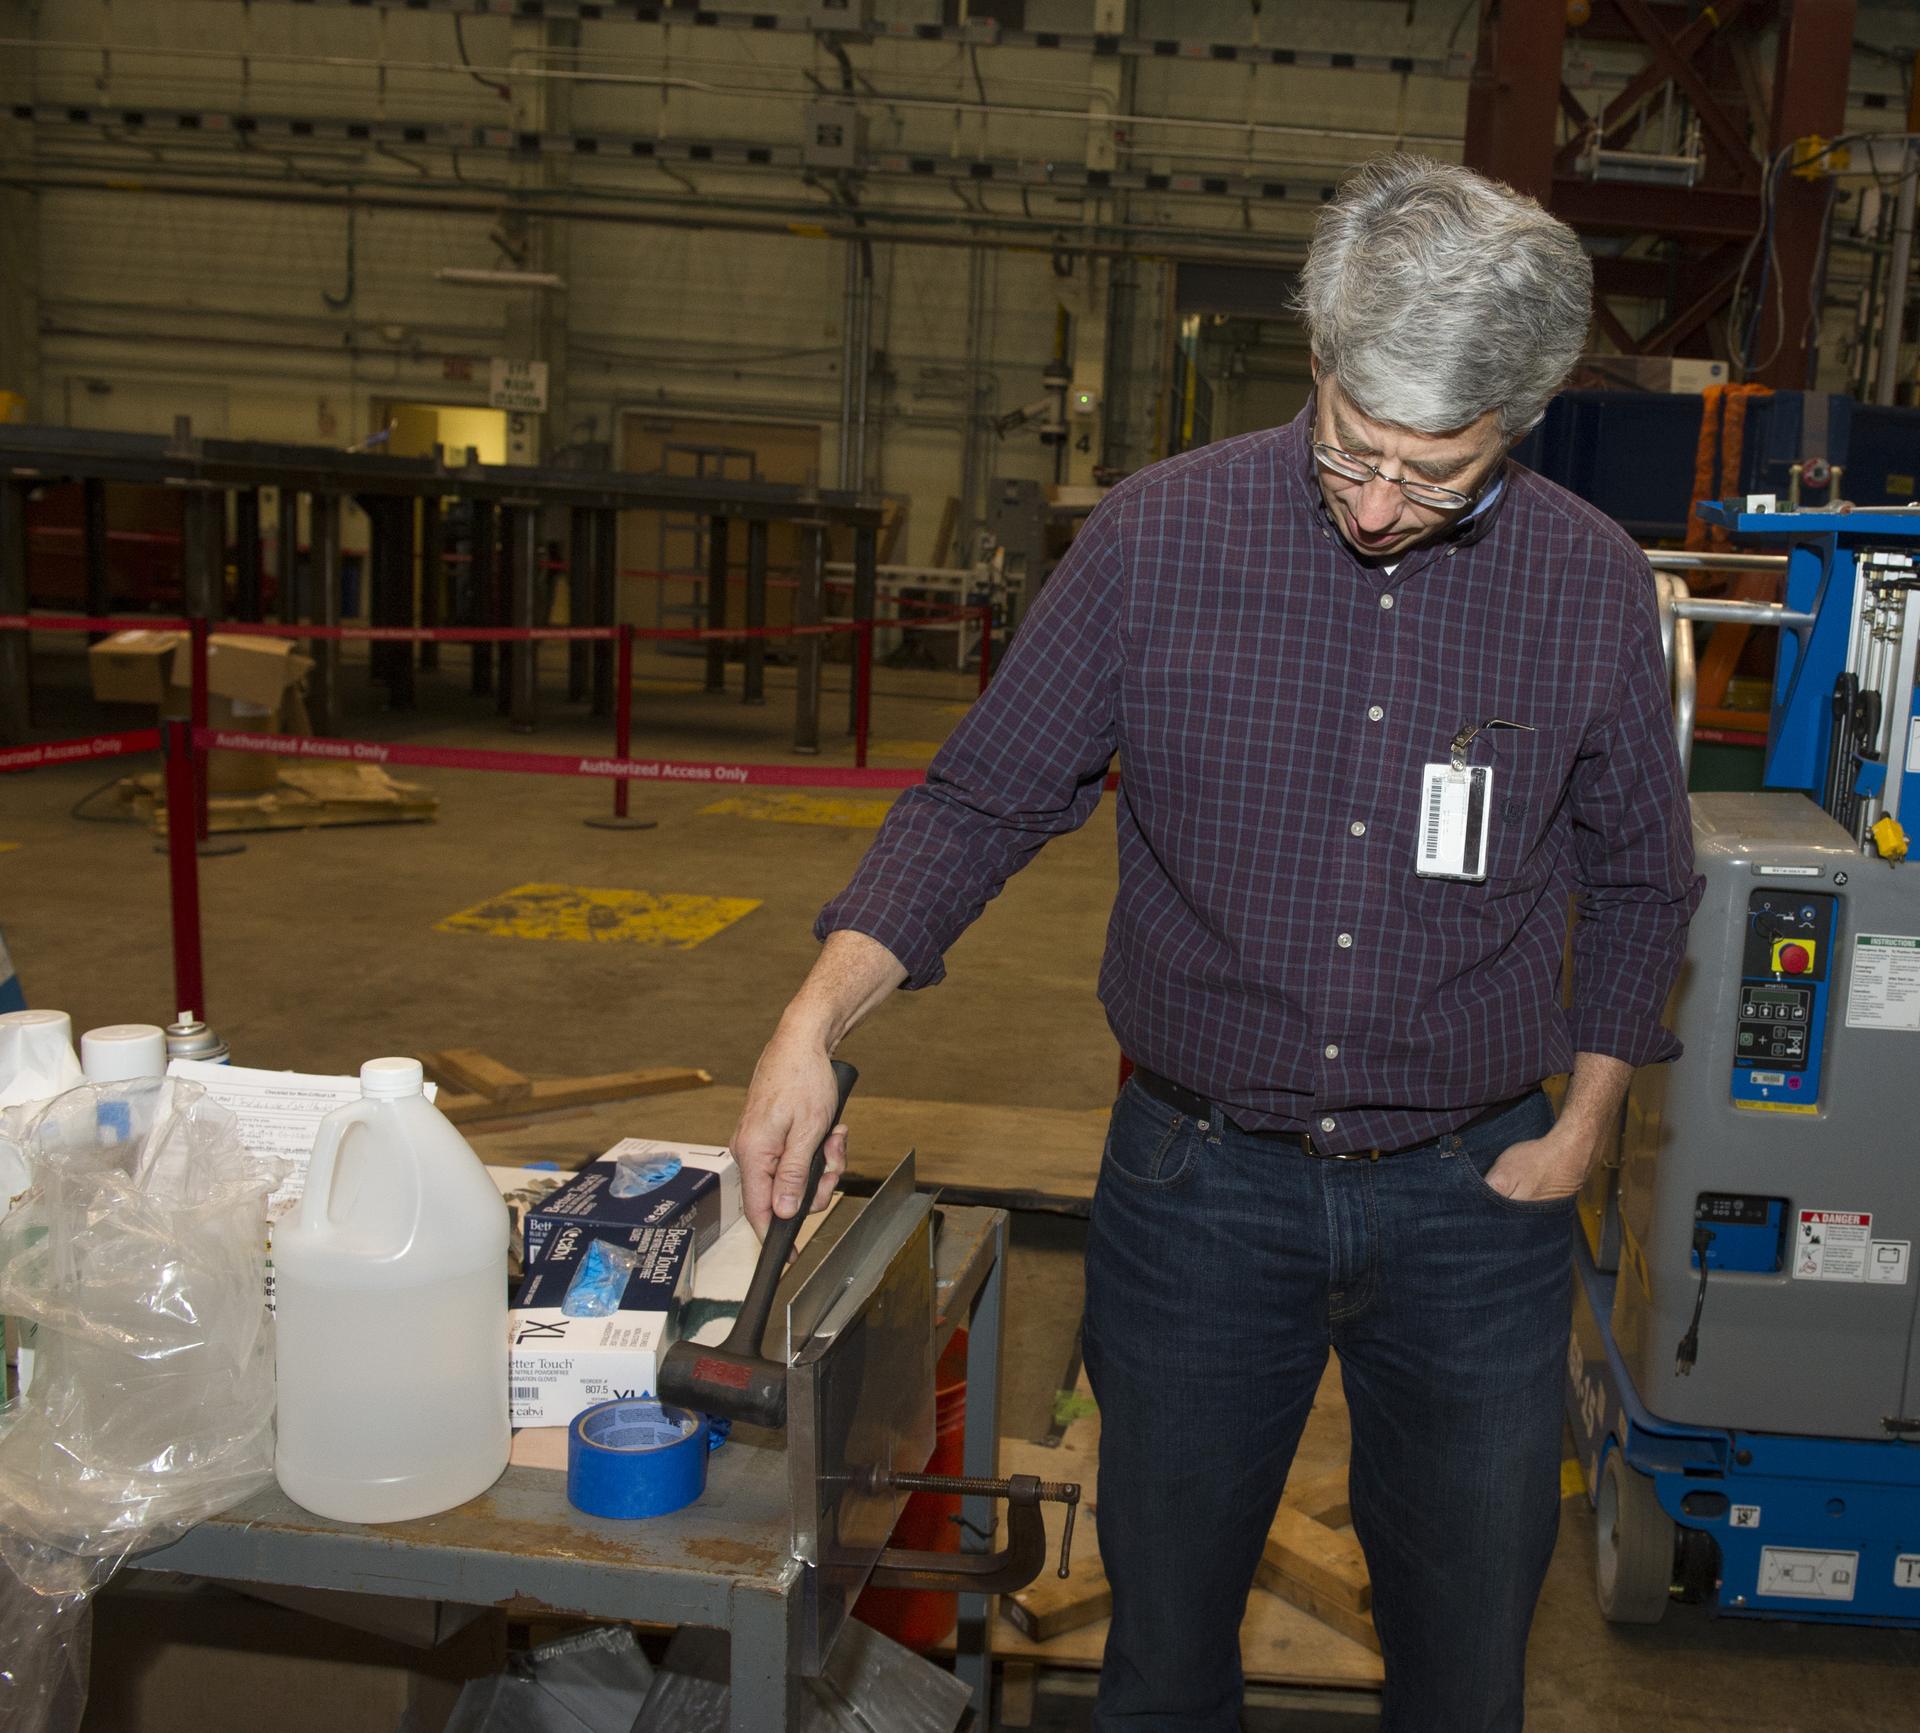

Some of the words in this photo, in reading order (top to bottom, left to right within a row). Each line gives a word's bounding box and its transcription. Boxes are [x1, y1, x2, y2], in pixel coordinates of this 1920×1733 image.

[1075, 432, 1091, 454] 4
[44, 745, 91, 760] Access
[92, 738, 122, 754] Only
[215, 732, 299, 752] Authorized
[301, 741, 350, 757] Access
[354, 743, 389, 762] Only
[579, 760, 659, 777] Authorized
[662, 764, 712, 779] Access
[714, 767, 748, 783] Only
[1870, 938, 1916, 947] INSTRUCTIONS
[1821, 1213, 1860, 1224] DANGER
[550, 1238, 578, 1261] cabvi
[661, 1229, 688, 1254] Better
[651, 1255, 679, 1283] Touch
[516, 1320, 570, 1345] XL
[539, 1358, 573, 1369] Touch
[585, 1385, 608, 1394] 807.5
[516, 1406, 544, 1416] cabvi
